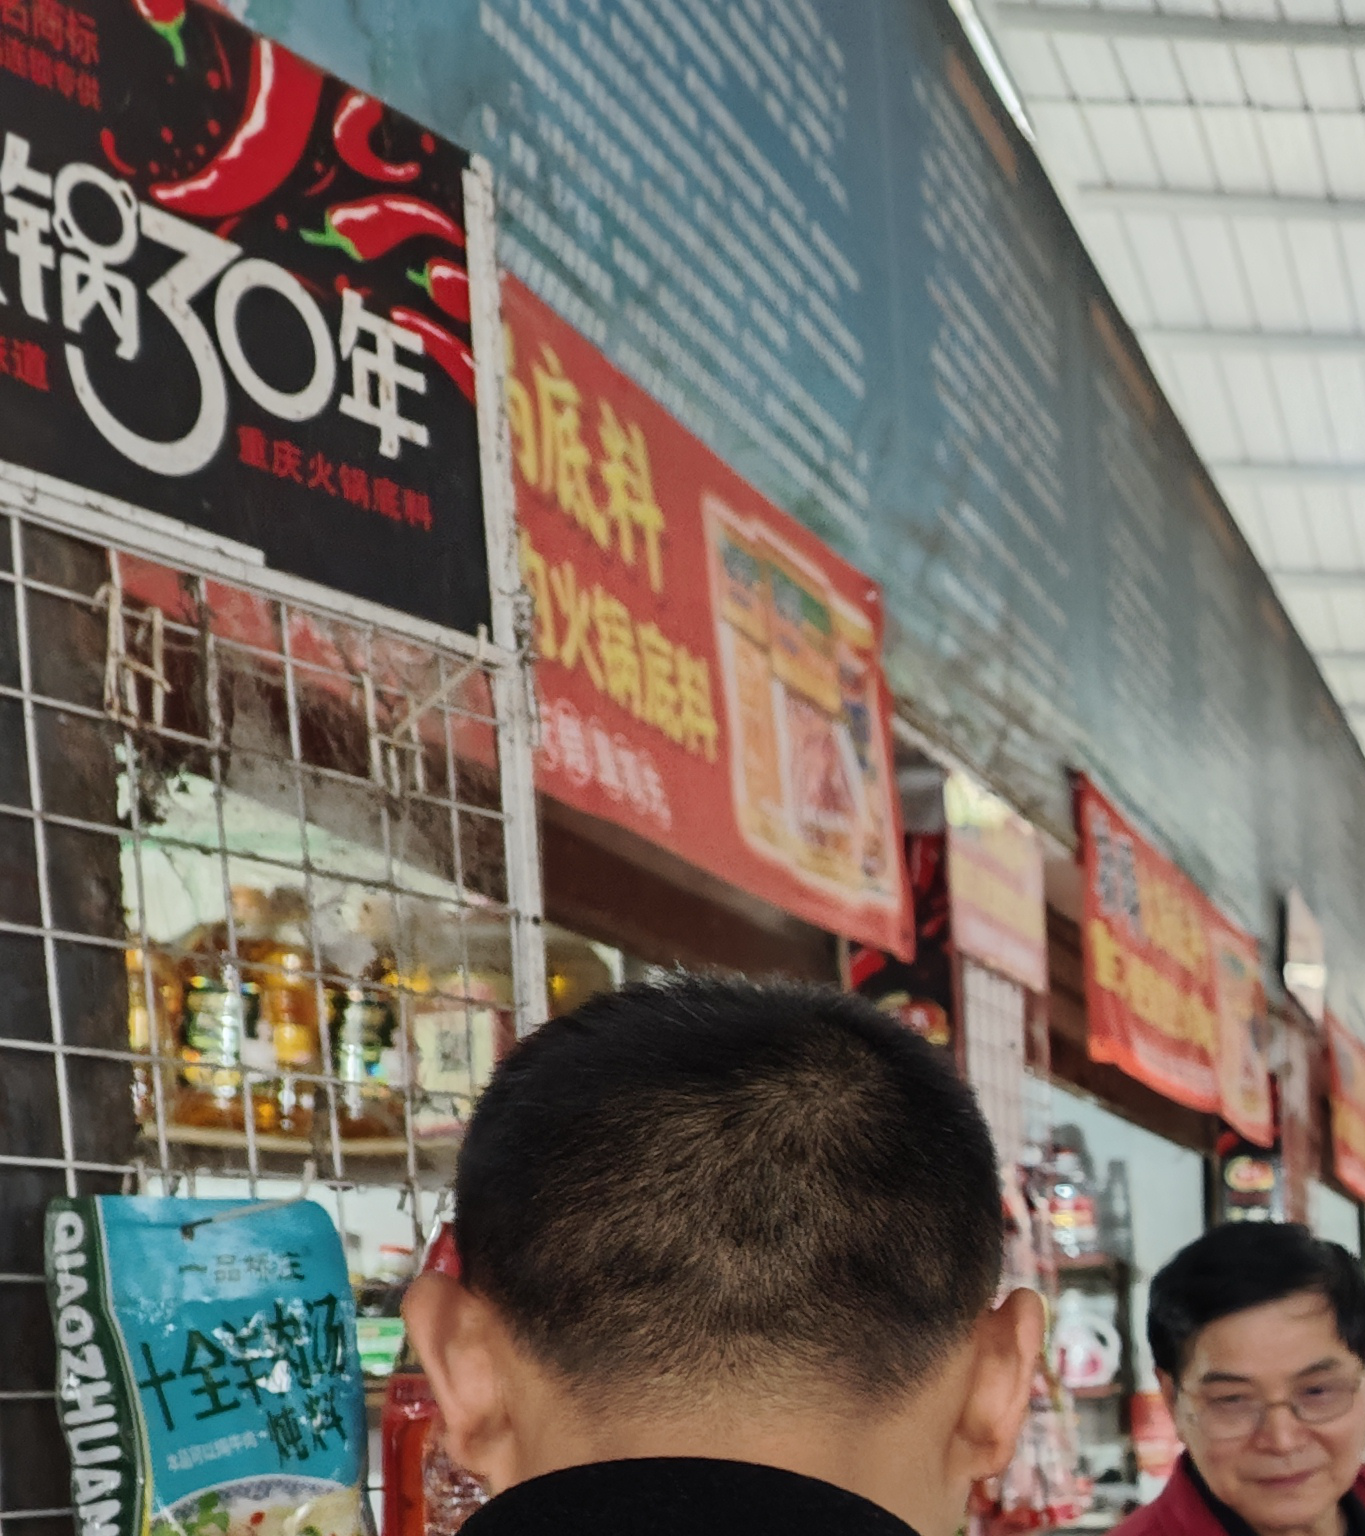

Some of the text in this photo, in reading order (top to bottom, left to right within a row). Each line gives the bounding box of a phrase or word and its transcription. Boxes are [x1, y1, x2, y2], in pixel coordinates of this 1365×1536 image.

[237, 424, 434, 533] 重庆火锅底料
